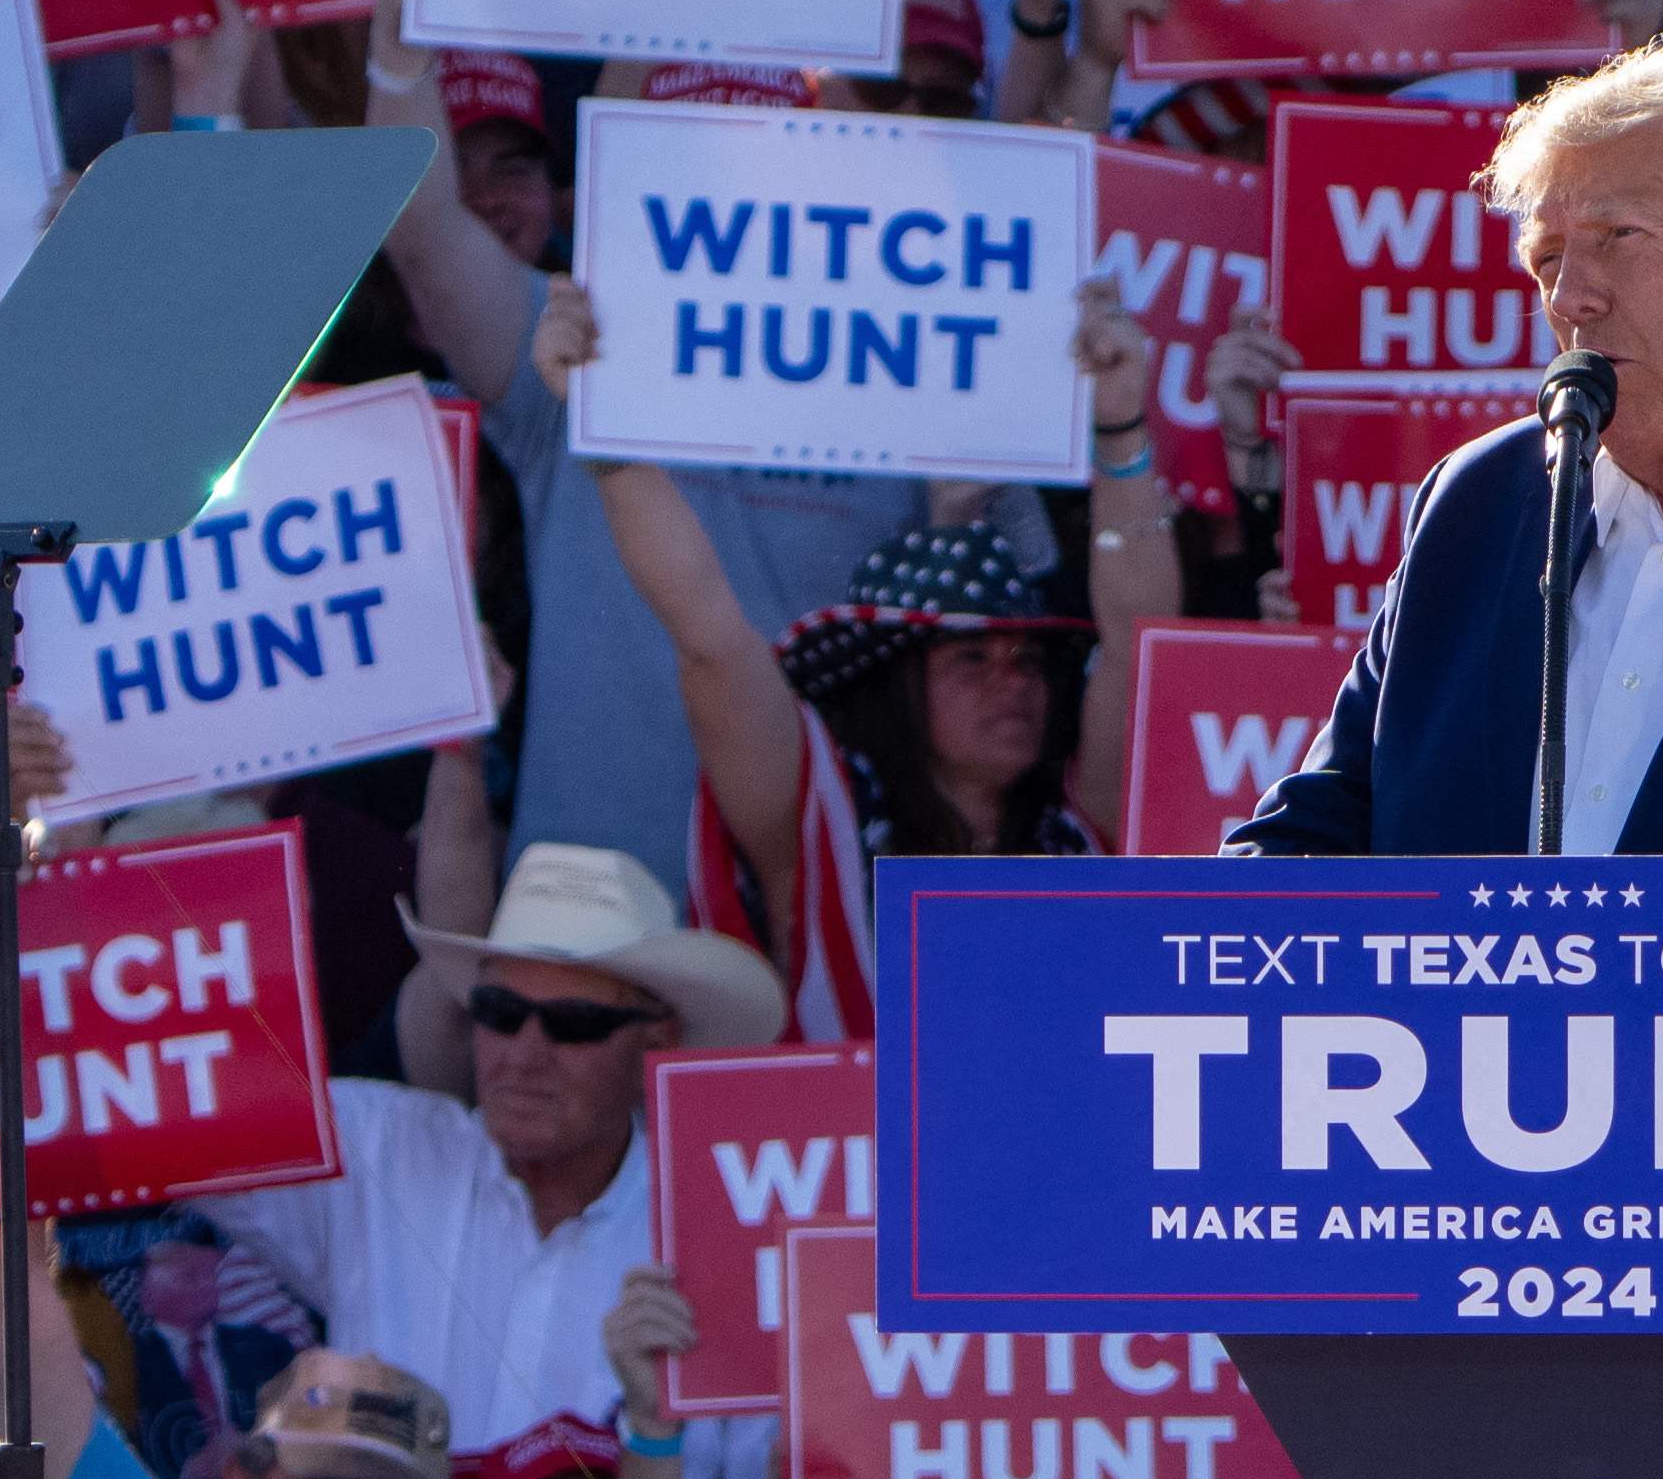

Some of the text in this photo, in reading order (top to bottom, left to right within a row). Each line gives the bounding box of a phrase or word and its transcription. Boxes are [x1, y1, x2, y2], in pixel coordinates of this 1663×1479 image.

[642, 194, 1033, 292] WITCH
[1097, 229, 1267, 324] WIT
[675, 302, 999, 392] HUNT
[1360, 286, 1540, 367] HU
[64, 478, 404, 626] WITCH
[97, 587, 387, 722] HUNT
[1163, 935, 1340, 985] TEXT
[1363, 935, 1596, 986] TEXAS
[1152, 1206, 1298, 1240] MAKE
[1319, 1205, 1561, 1240] AMERICA
[1457, 1267, 1656, 1318] 2024
[849, 1312, 1249, 1399] WITCH
